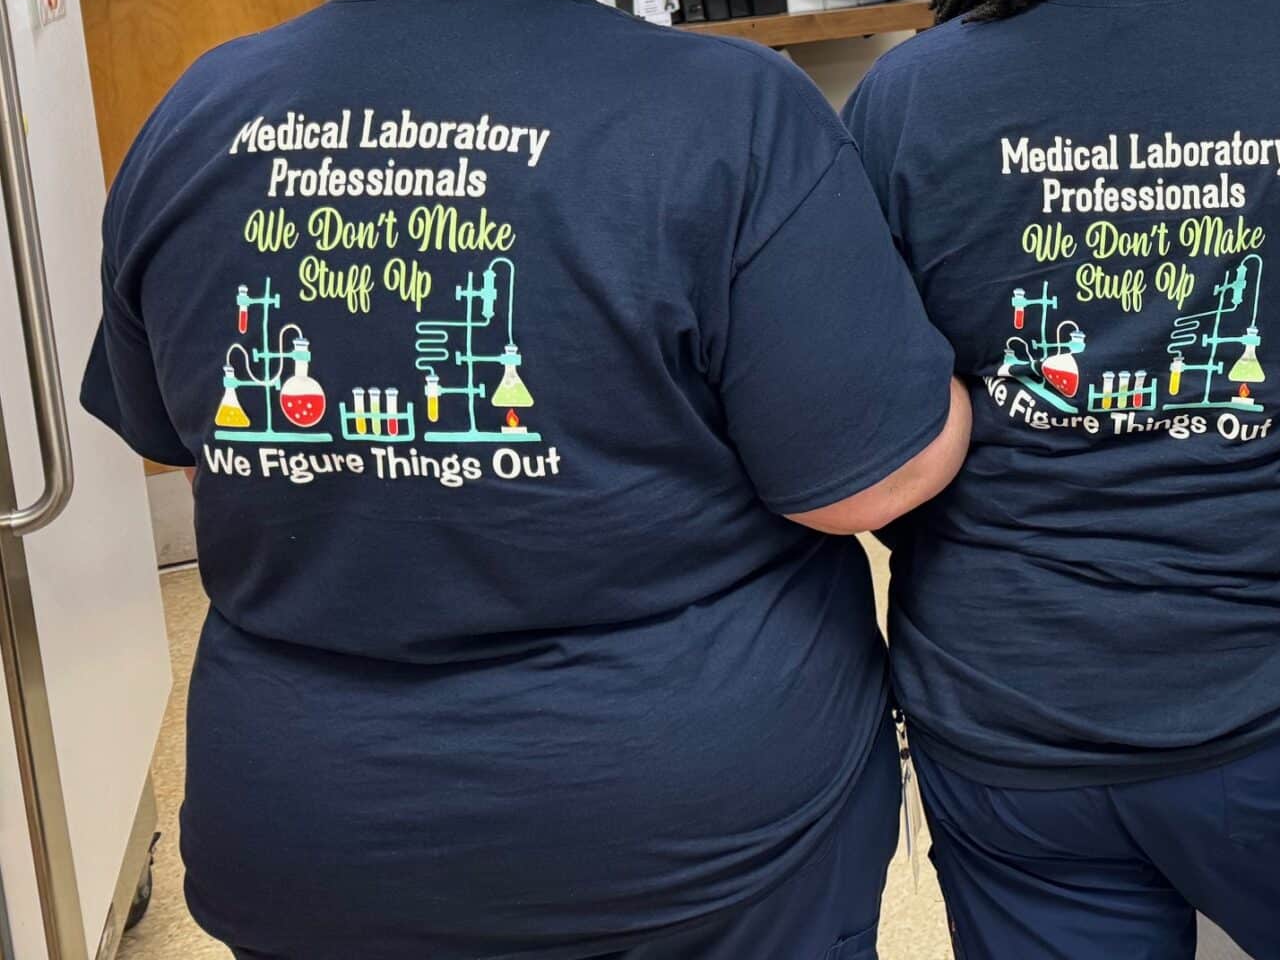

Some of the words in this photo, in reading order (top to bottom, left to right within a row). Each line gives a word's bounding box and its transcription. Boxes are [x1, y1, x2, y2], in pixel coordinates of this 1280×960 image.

[229, 109, 351, 154] Medical
[359, 109, 550, 167] Laboratory
[1001, 134, 1119, 174] Medical
[268, 157, 487, 197] Professionals
[1042, 173, 1246, 213] Professionals
[244, 208, 298, 252] We
[308, 207, 399, 251] Don't
[408, 204, 516, 252] Make
[1022, 222, 1077, 262] We
[1085, 220, 1171, 259] Don't
[1179, 215, 1266, 257] Make
[299, 256, 374, 313] Stuff
[384, 257, 432, 312] Up
[1075, 263, 1146, 313] Stuff
[1155, 262, 1195, 311] Up
[1009, 389, 1099, 433] Figure
[1110, 412, 1207, 439] Things
[1217, 413, 1272, 441] Out
[203, 444, 251, 477] We
[259, 447, 364, 484] Figure
[371, 446, 482, 487] Things
[492, 447, 561, 479] Out
